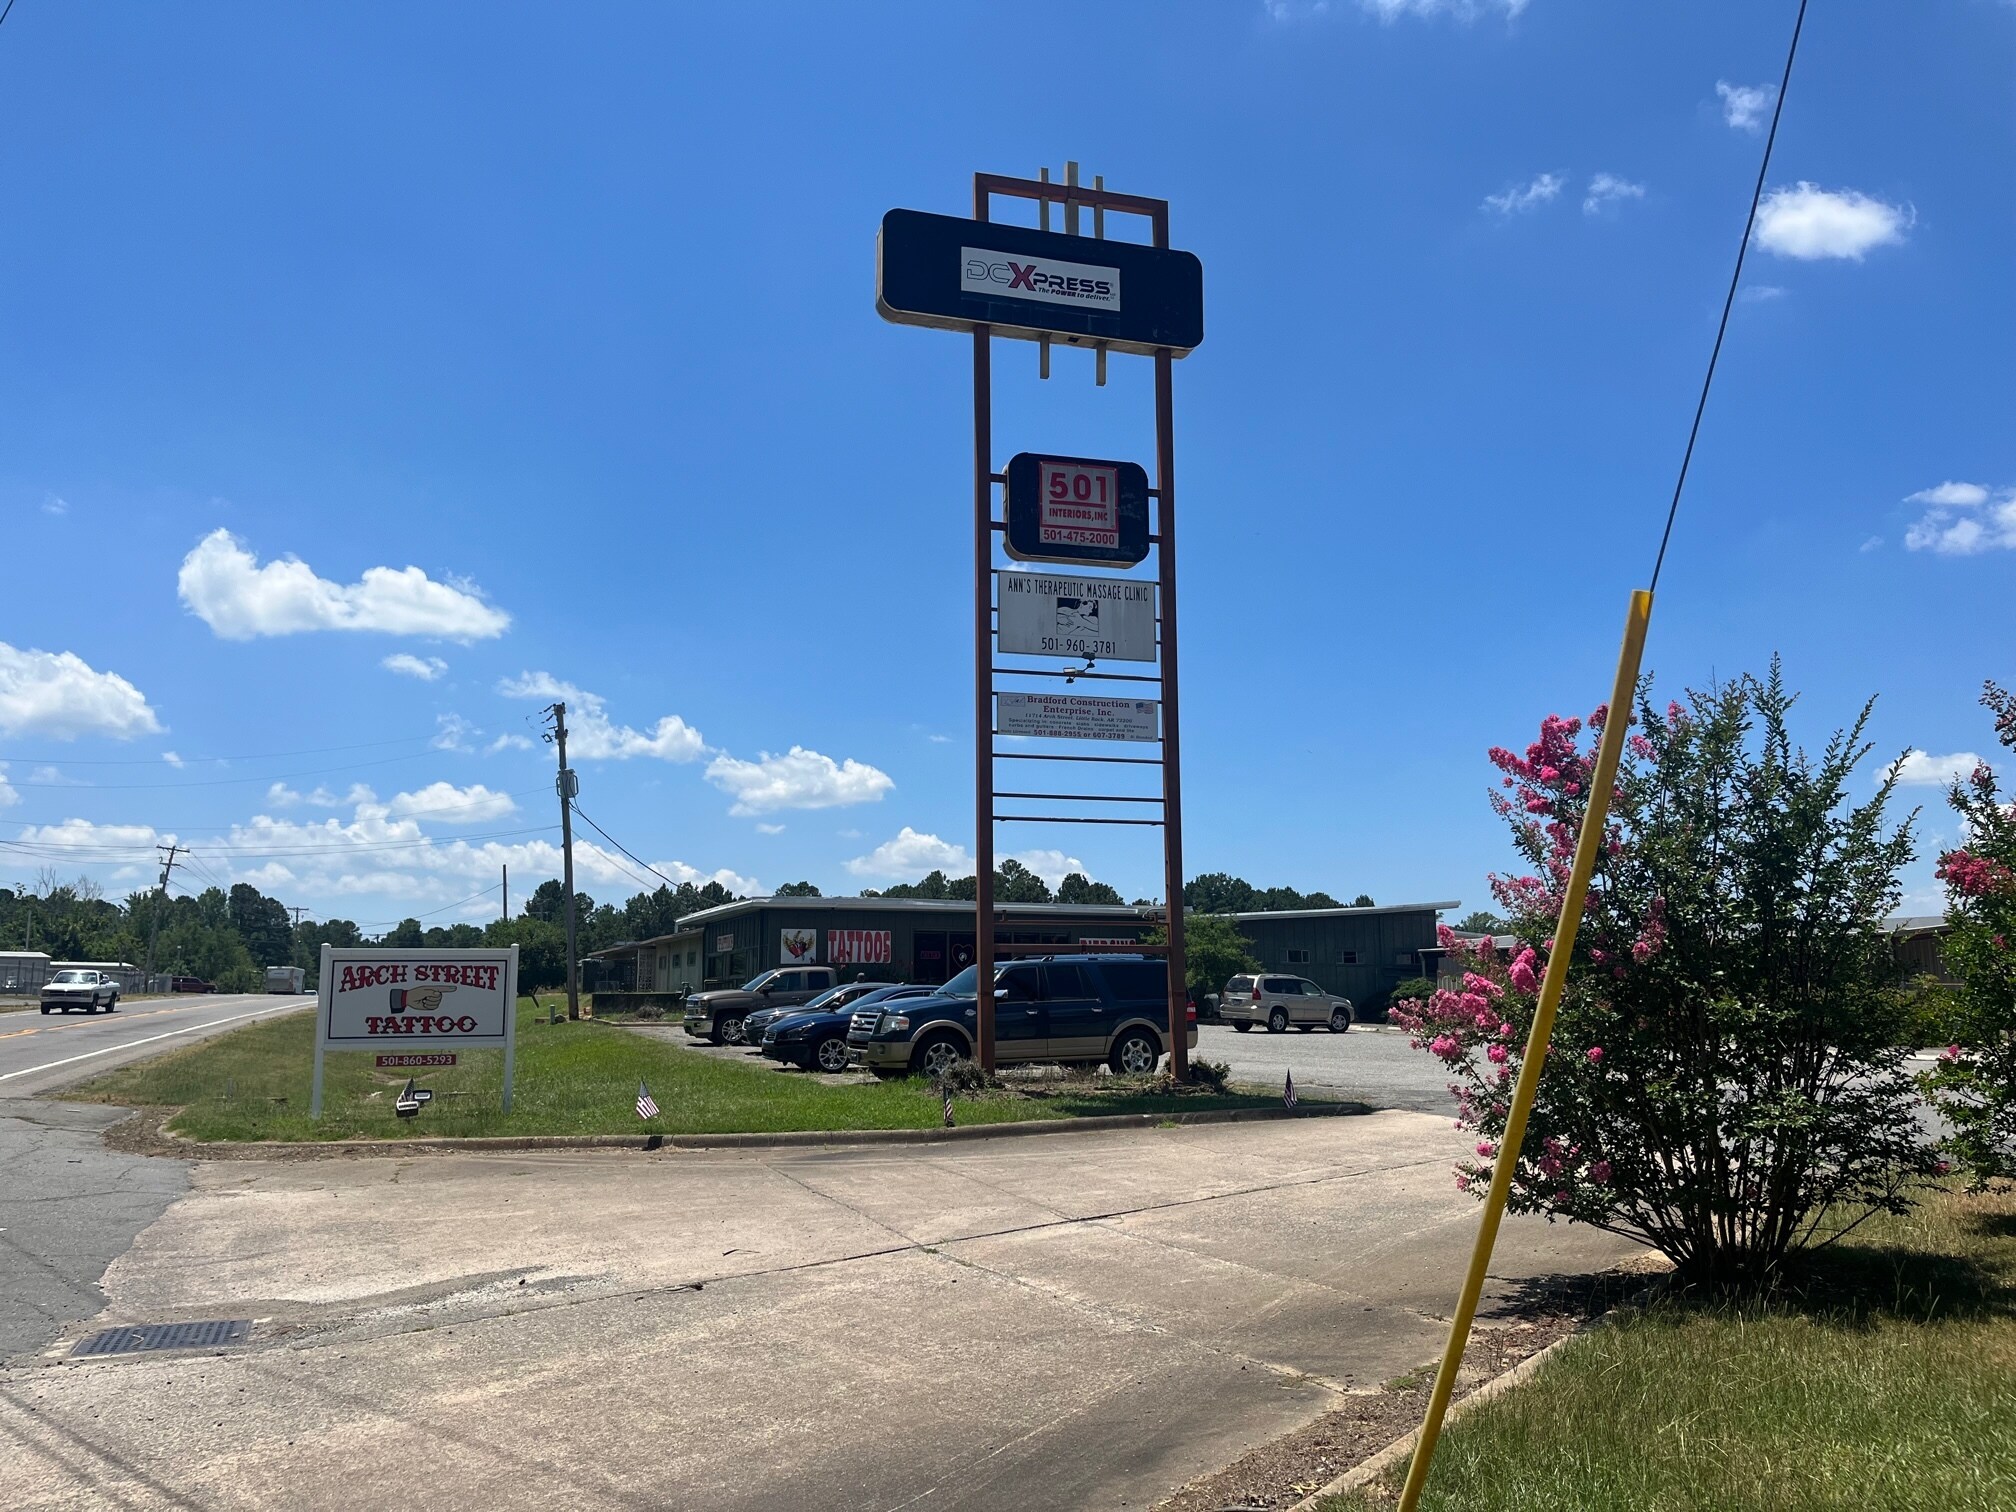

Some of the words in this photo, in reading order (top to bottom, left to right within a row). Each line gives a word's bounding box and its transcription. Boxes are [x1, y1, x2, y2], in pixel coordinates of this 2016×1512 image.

[1050, 288, 1076, 298] POWER
[1049, 471, 1107, 502] 501
[1043, 529, 1115, 545] 501-475-2000
[1007, 577, 1031, 594] ANN'S
[1034, 579, 1084, 598] THERAPEUTIC
[1087, 583, 1121, 600] MASSAGE
[1124, 586, 1148, 602] CLINIC
[1027, 695, 1067, 705] Bradford
[1070, 697, 1130, 709] Construction
[1097, 708, 1115, 716] Inc.
[828, 930, 891, 963] TATTOOS
[338, 965, 409, 993] ARCH
[414, 965, 499, 991] STREET
[365, 1015, 478, 1034] TATTOO
[382, 1056, 452, 1066] 501-860-5293
